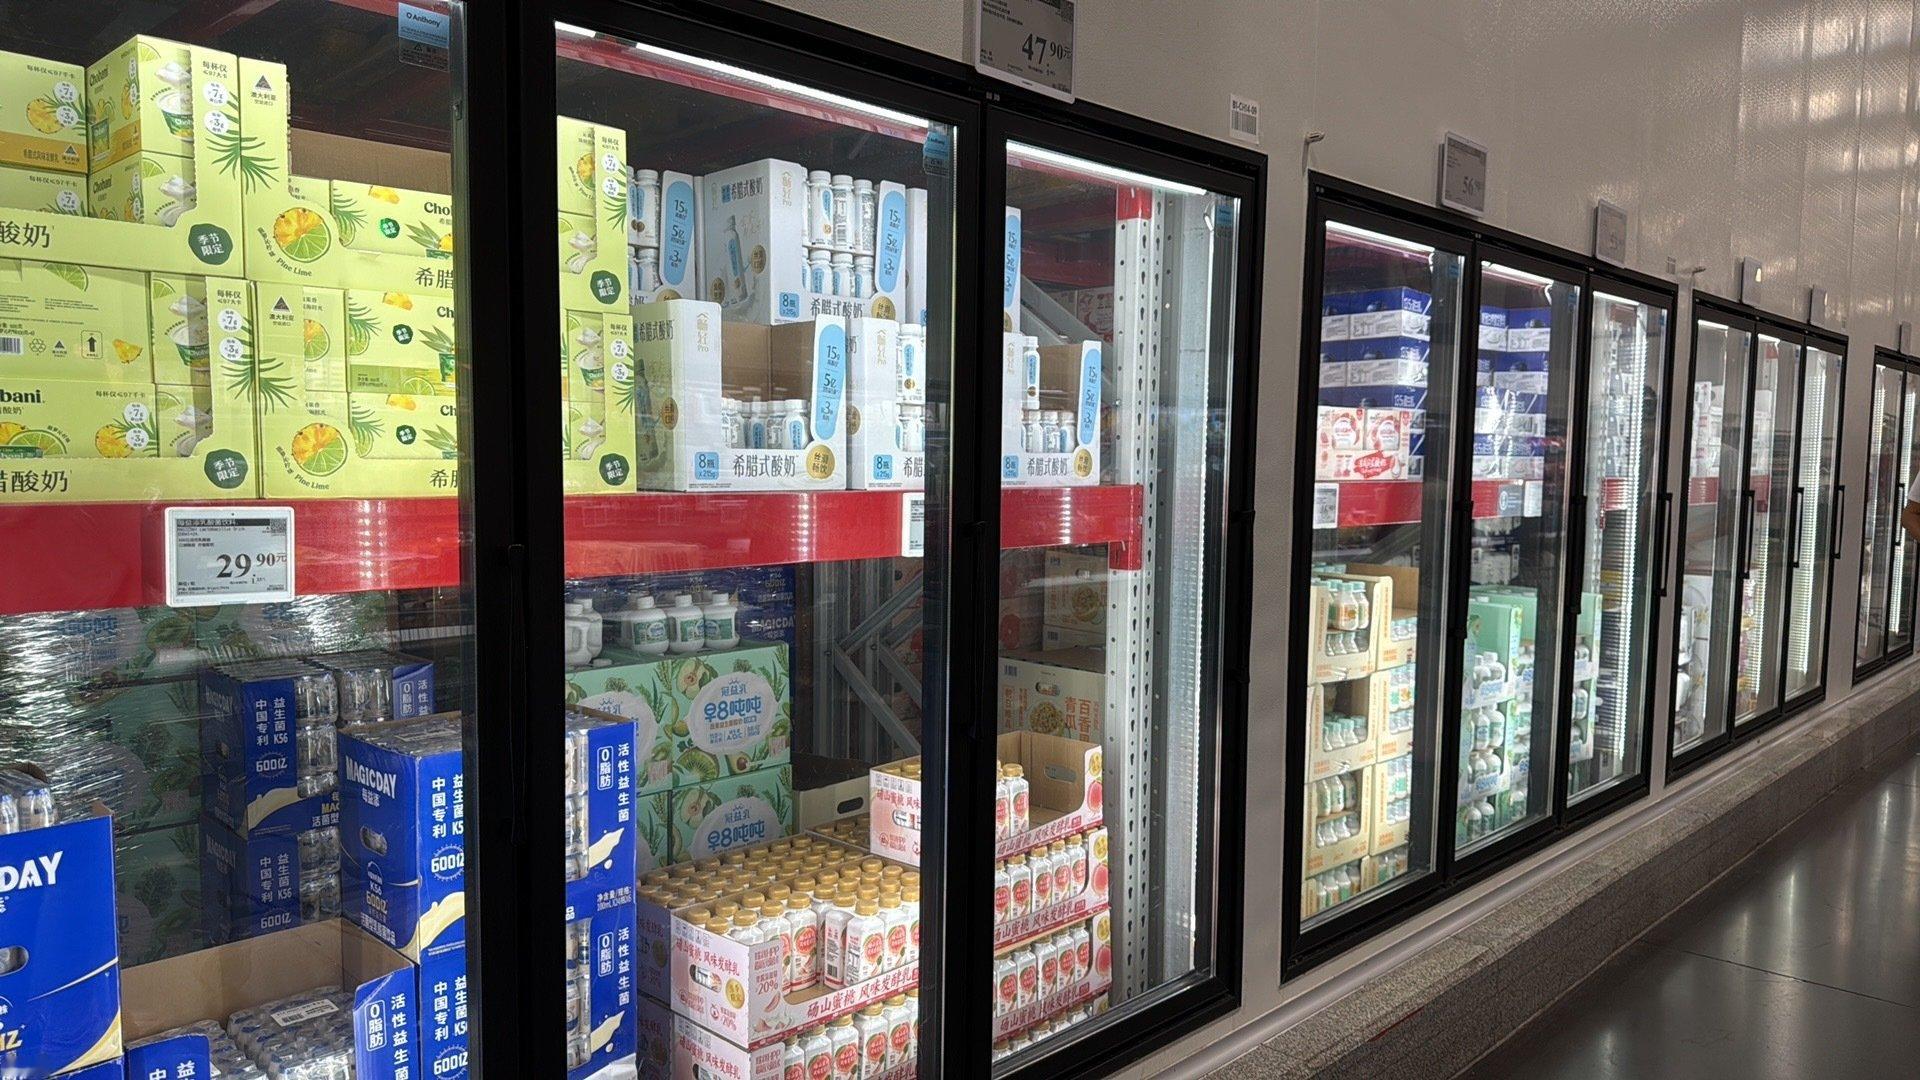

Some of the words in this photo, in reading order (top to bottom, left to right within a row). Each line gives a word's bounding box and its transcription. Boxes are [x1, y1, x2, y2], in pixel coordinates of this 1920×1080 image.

[424, 201, 452, 216] Cho
[198, 234, 220, 244] 季节
[201, 244, 225, 256] 限定
[0, 469, 68, 492] 酸奶
[213, 457, 235, 470] 季节
[216, 468, 240, 482] 限定
[732, 454, 797, 478] 希腊式酸奶
[254, 698, 269, 746] 中国专利
[255, 757, 289, 774] 600亿
[345, 754, 397, 800] MAGICDAY
[599, 748, 613, 788] 0脂肪
[617, 742, 630, 824] 活性益生菌
[431, 776, 448, 839] 中国专利
[260, 856, 273, 902] 中国专利
[260, 911, 292, 929] 600亿
[599, 934, 612, 975] 0脂肪
[617, 926, 630, 1007] 活性益生菌
[859, 968, 912, 999] 风味发酵乳
[433, 981, 449, 1042] 中国专利
[454, 975, 468, 1037] 益生菌K5
[368, 1003, 385, 1050] 0脂肪
[433, 1051, 468, 1075] 600亿
